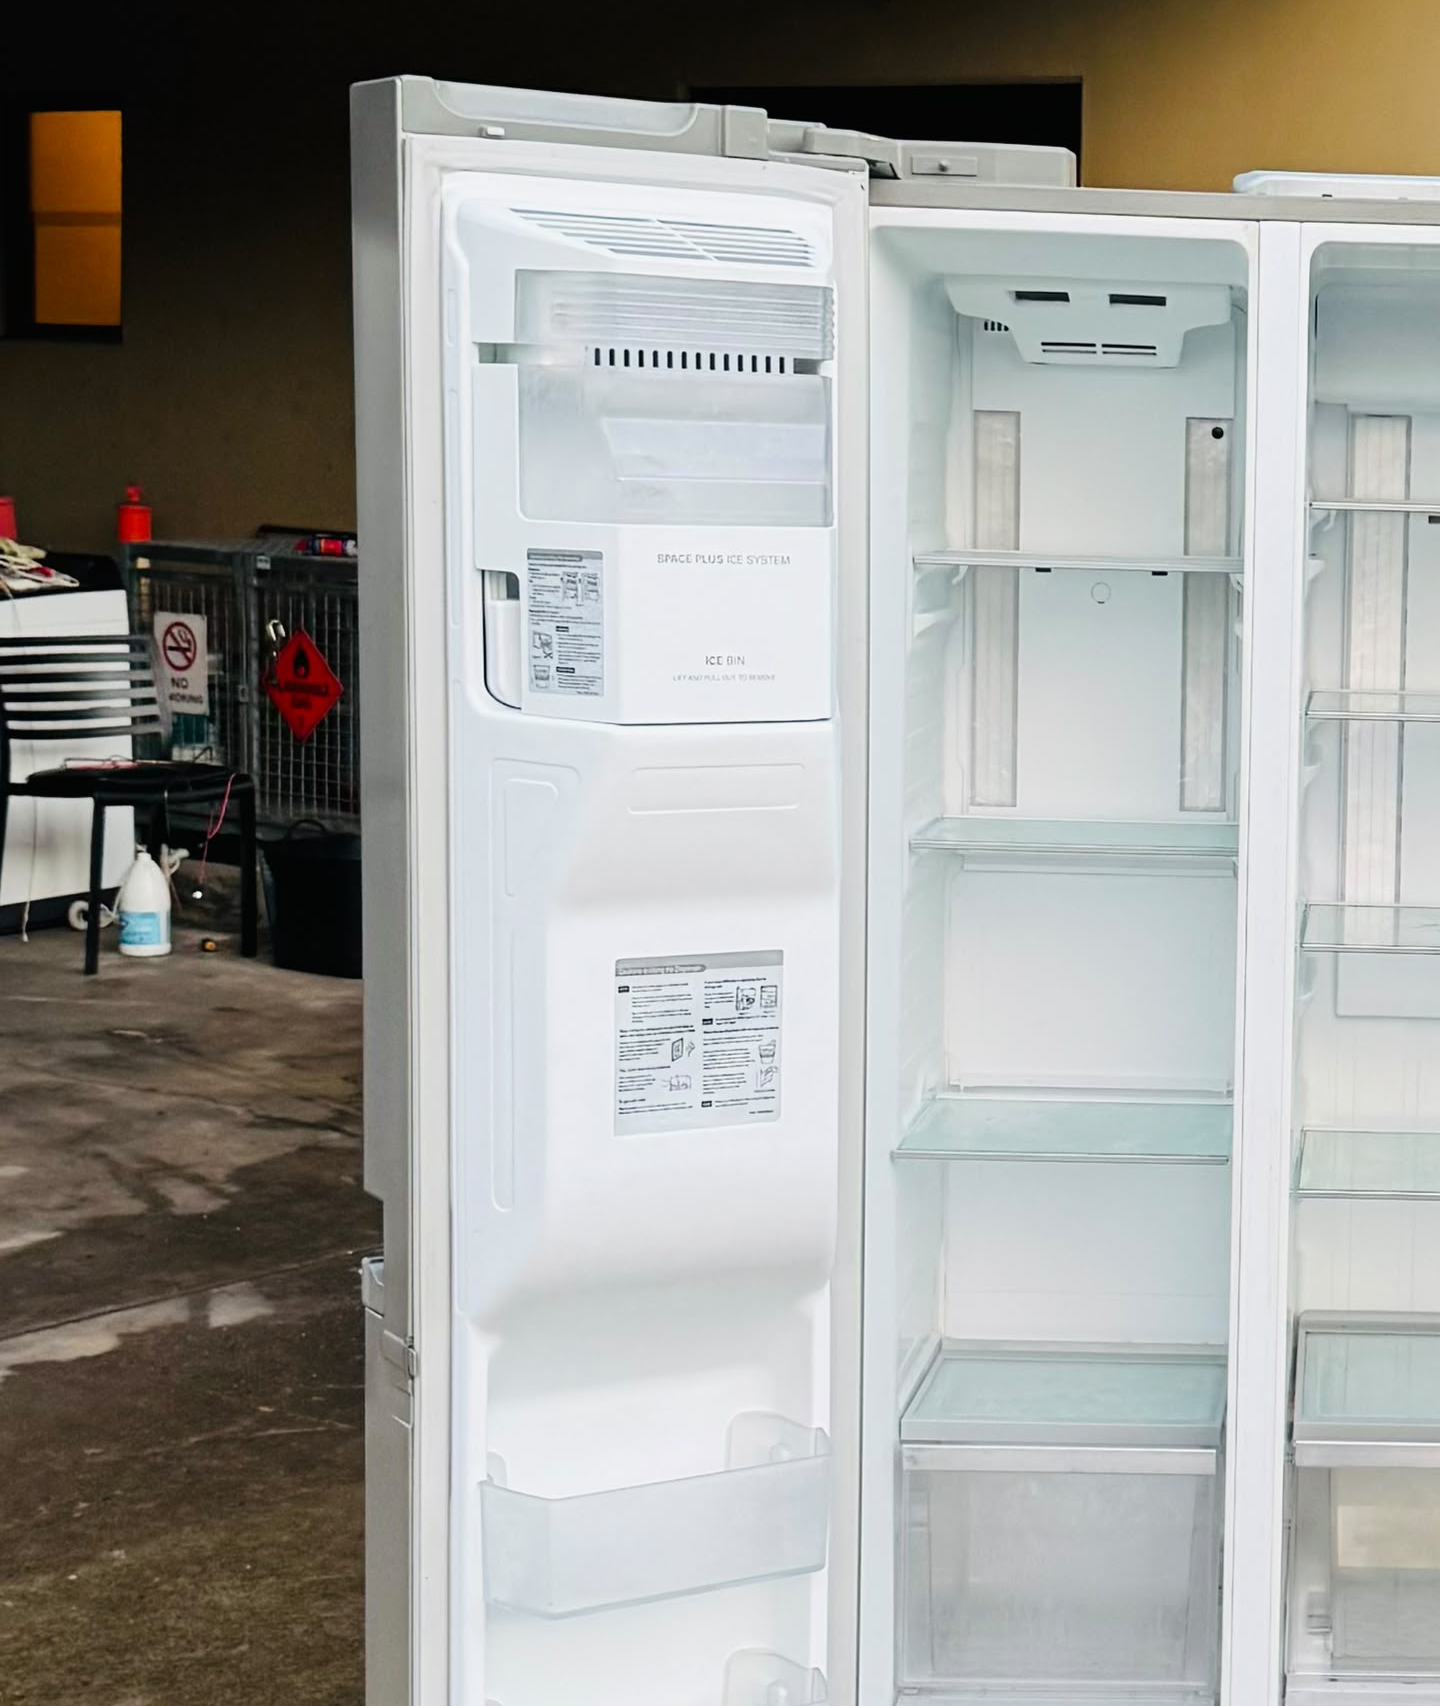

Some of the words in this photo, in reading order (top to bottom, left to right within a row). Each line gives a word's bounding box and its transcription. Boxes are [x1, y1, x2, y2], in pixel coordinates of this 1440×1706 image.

[656, 553, 693, 564] SPACE
[695, 554, 724, 564] PLUS
[727, 554, 744, 565] ICE
[746, 555, 791, 565] SYSTEM
[705, 656, 723, 666] ICE
[726, 656, 745, 666] BIN
[171, 677, 189, 689] NO
